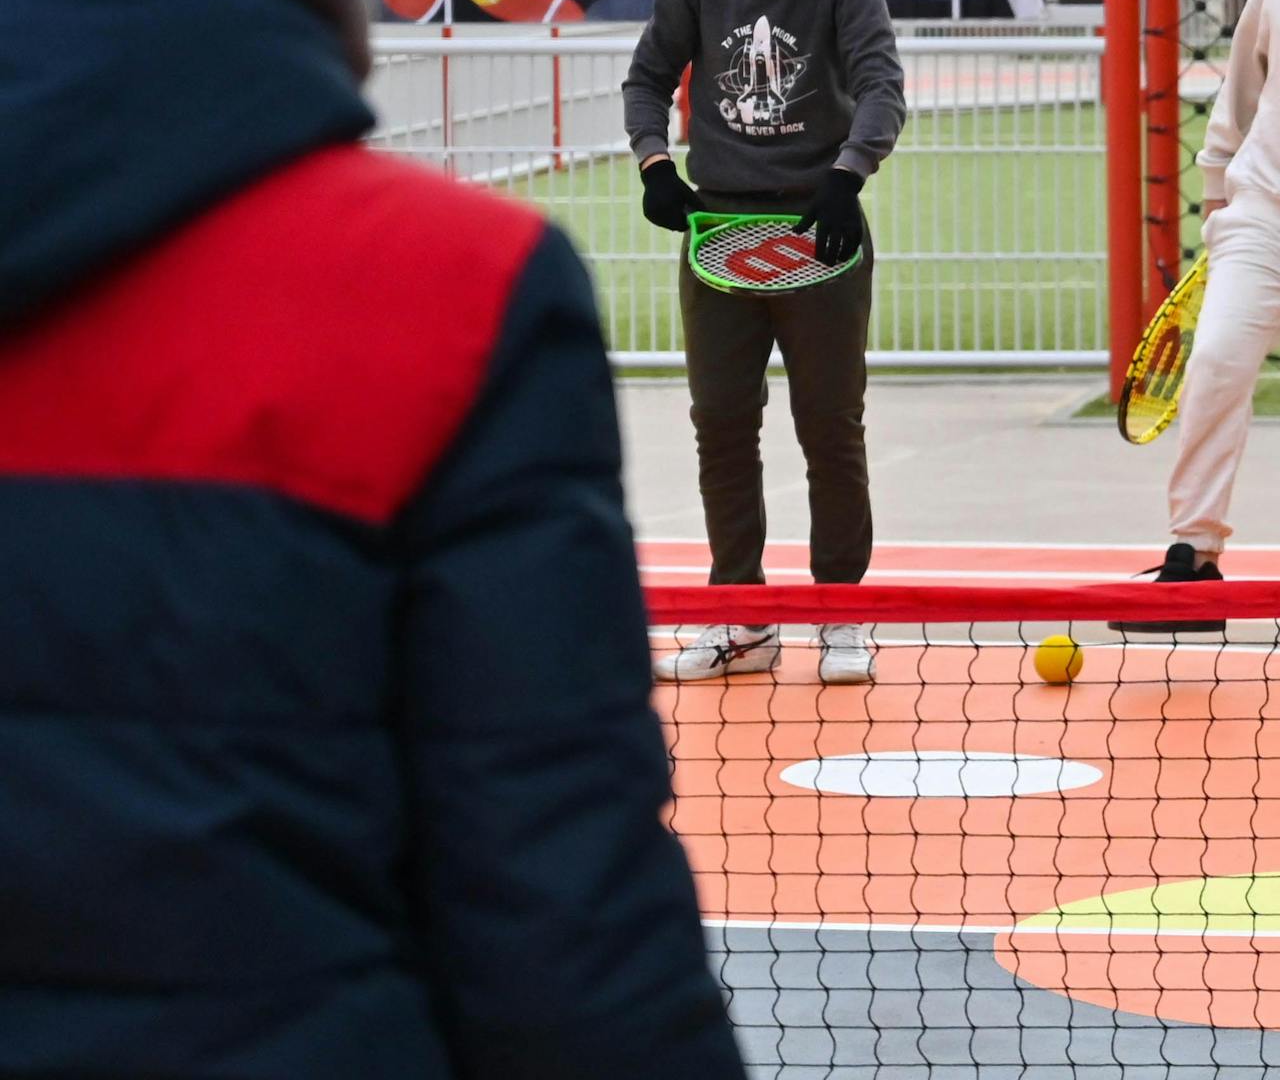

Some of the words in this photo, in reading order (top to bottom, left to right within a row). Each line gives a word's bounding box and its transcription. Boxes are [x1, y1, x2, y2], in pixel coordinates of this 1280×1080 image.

[721, 36, 733, 49] TO
[733, 24, 753, 38] THE
[745, 124, 775, 136] NEVER
[779, 122, 805, 134] BACK
